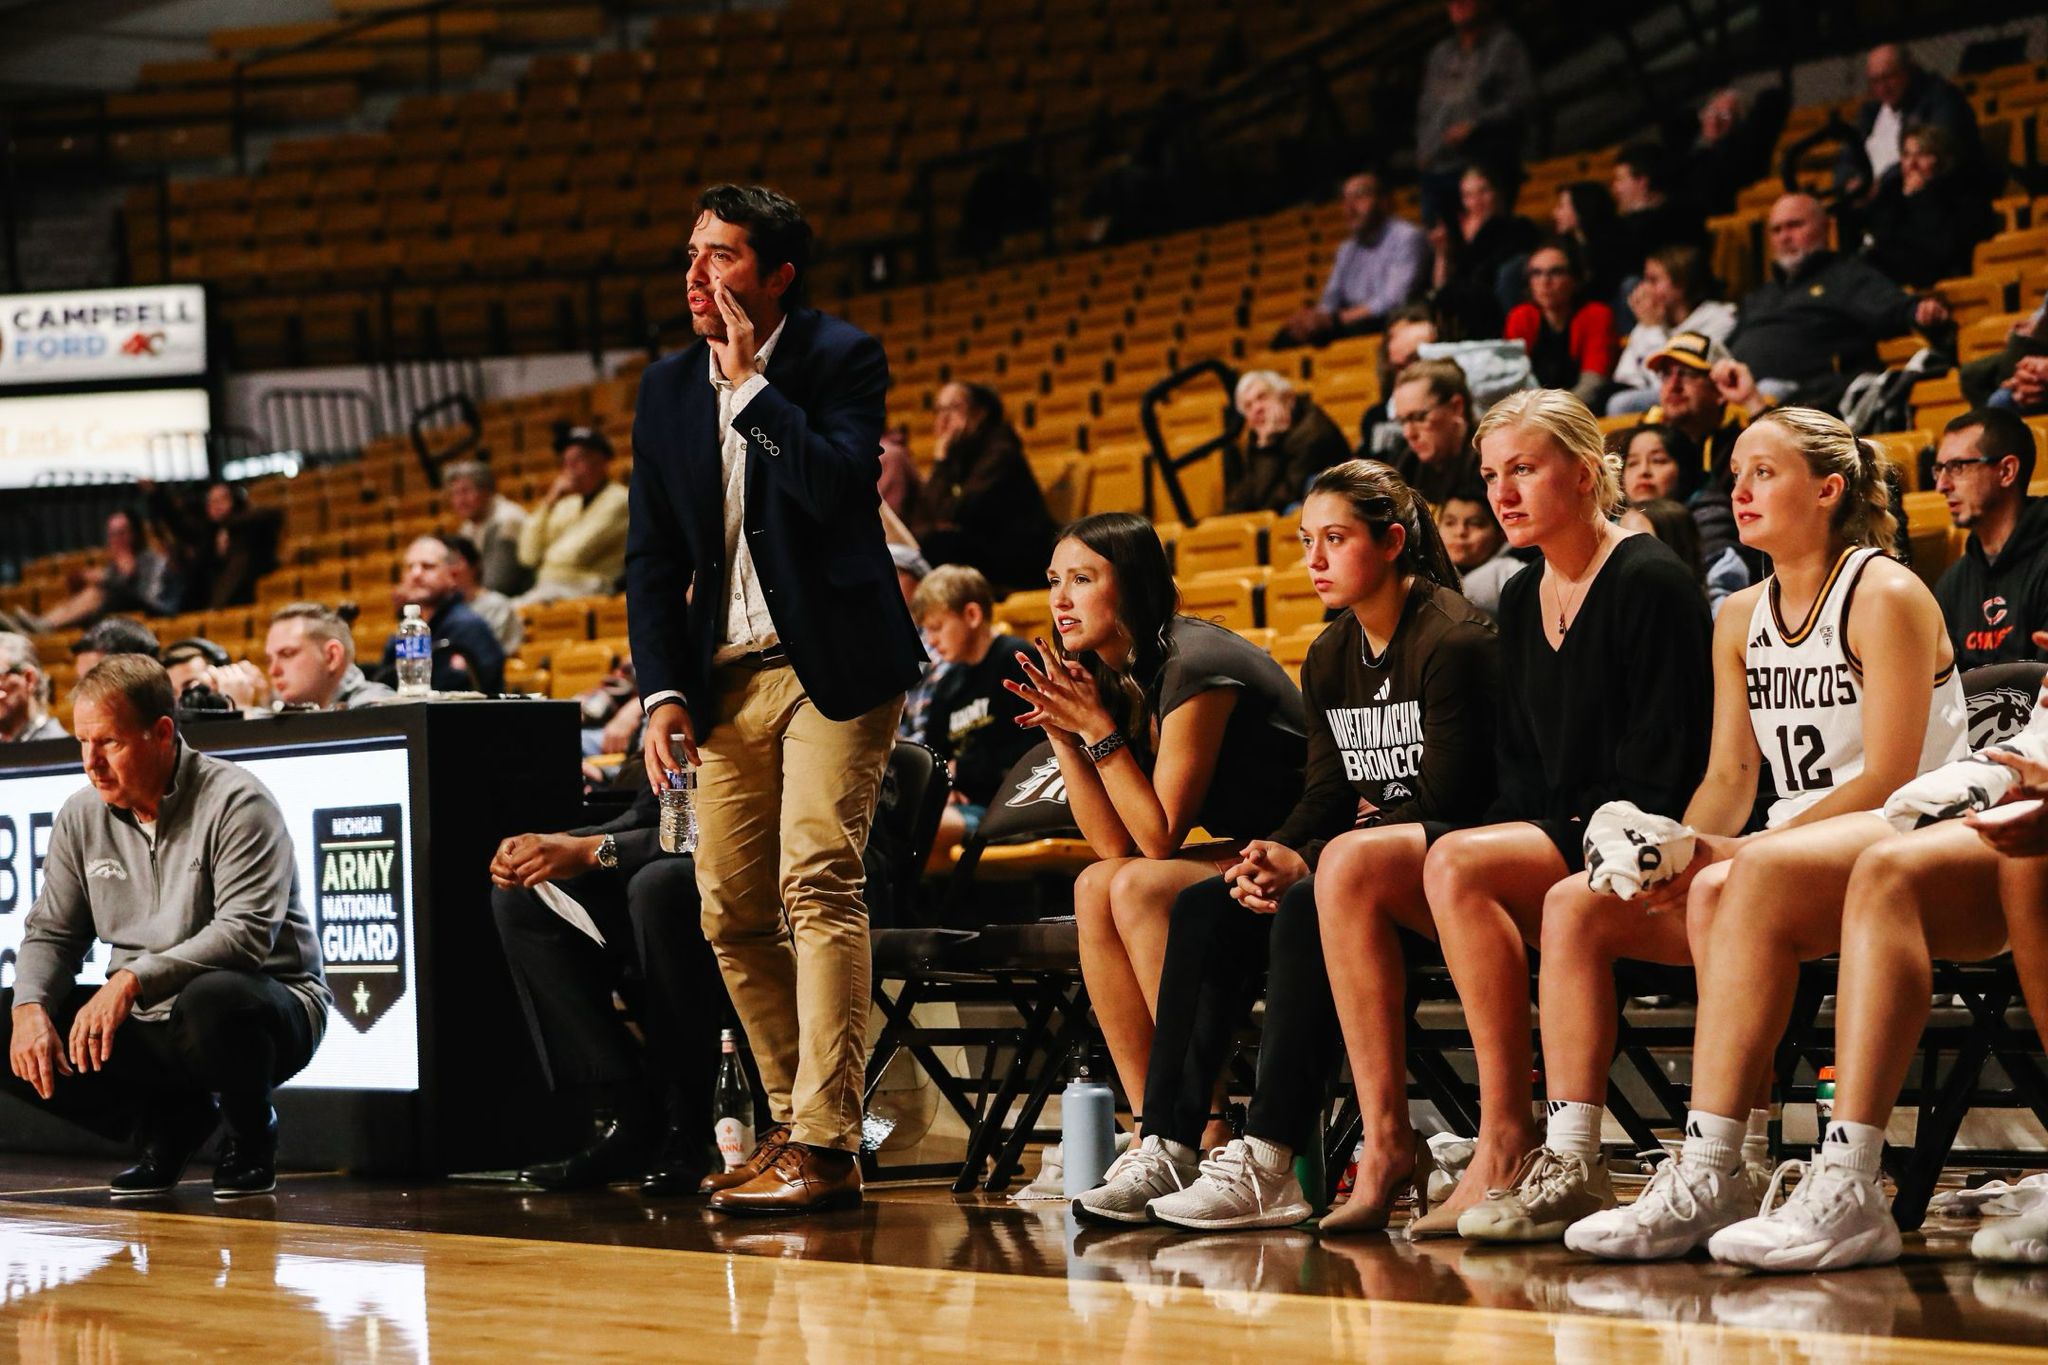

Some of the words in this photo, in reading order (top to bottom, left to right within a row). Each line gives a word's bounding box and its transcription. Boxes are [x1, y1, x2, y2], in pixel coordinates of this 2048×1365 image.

[13, 301, 197, 332] CAMPBELL
[15, 334, 107, 362] FORD
[1746, 664, 1857, 710] BRONCOS
[1341, 743, 1424, 781] BONCO
[1776, 725, 1834, 791] 12
[331, 816, 383, 836] MICHIGAN
[322, 850, 395, 891] ARMY
[321, 893, 398, 921] NATIONAL
[322, 923, 398, 962] GUARD
